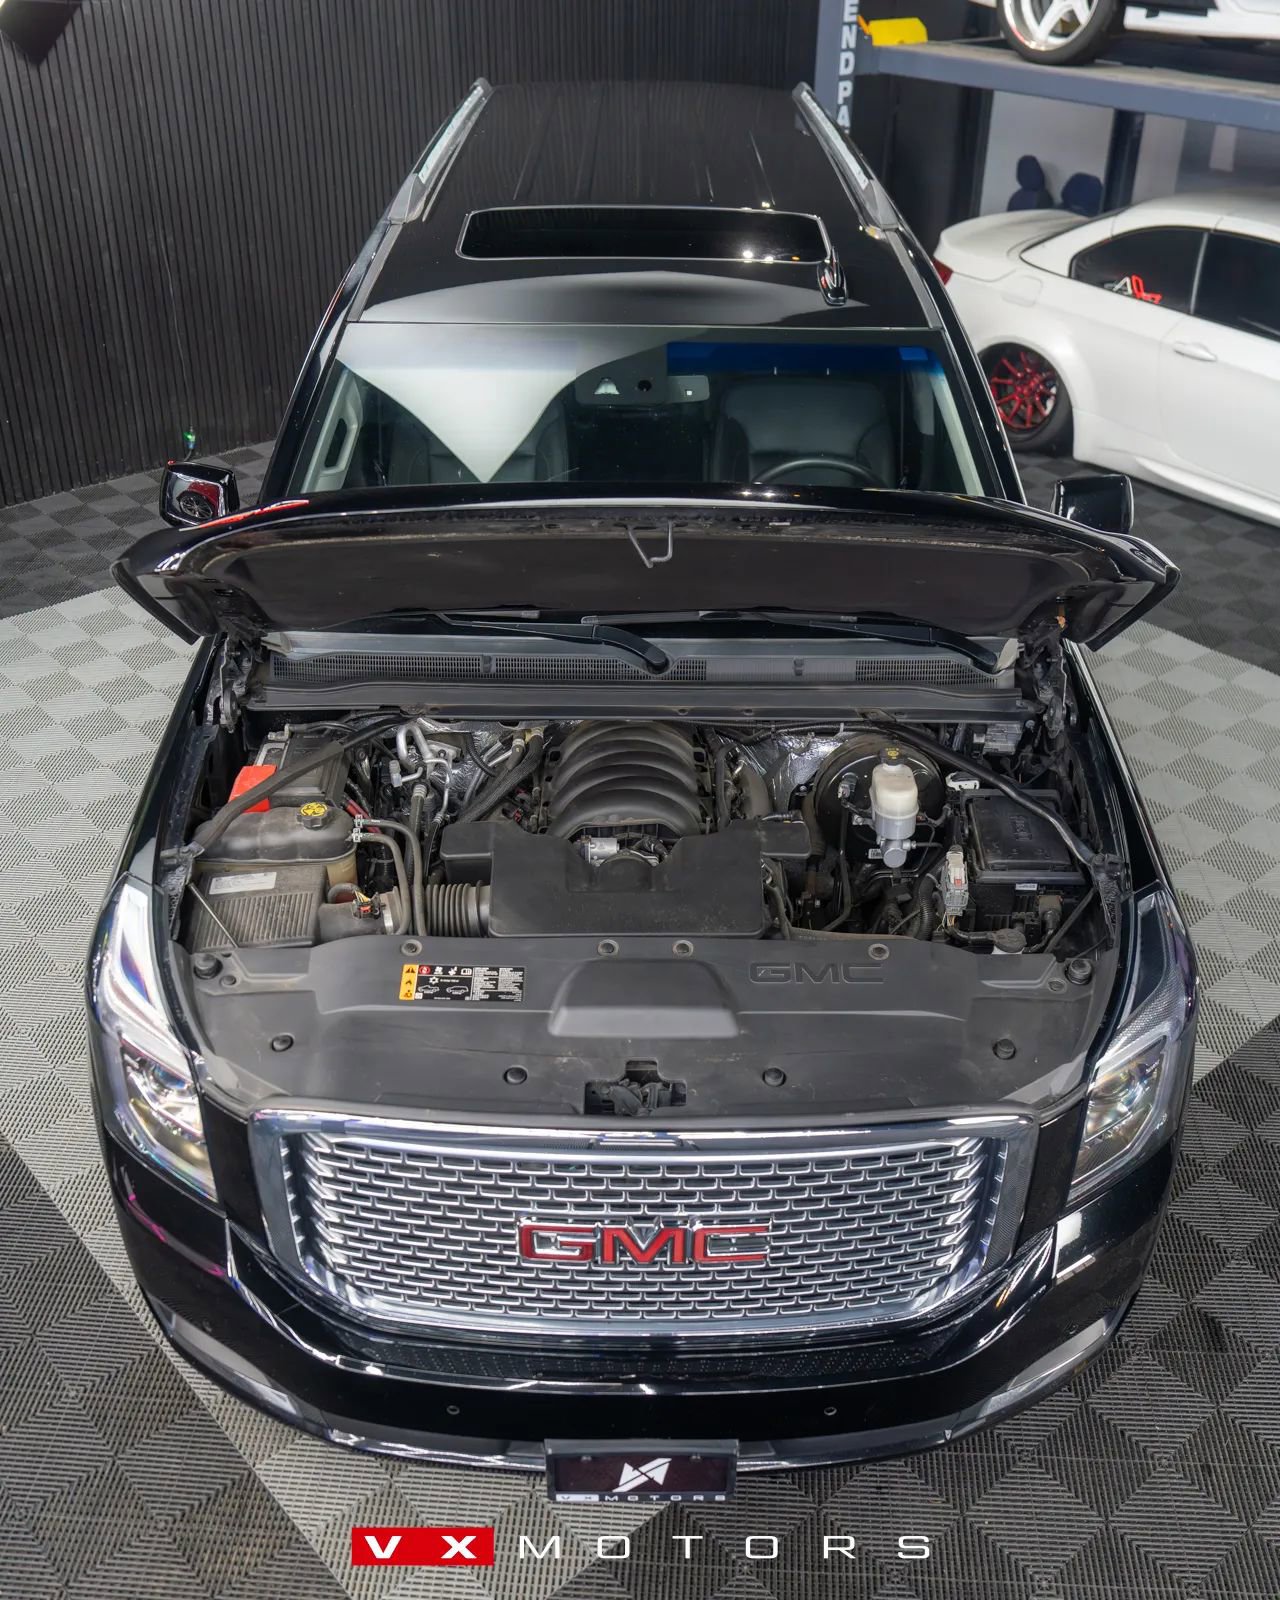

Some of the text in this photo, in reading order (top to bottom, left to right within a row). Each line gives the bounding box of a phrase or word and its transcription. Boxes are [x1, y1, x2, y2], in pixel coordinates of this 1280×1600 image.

[837, 0, 859, 135] ENDPA
[748, 962, 884, 985] GMC
[516, 1217, 773, 1265] GMC
[604, 1494, 726, 1502] MOTORS
